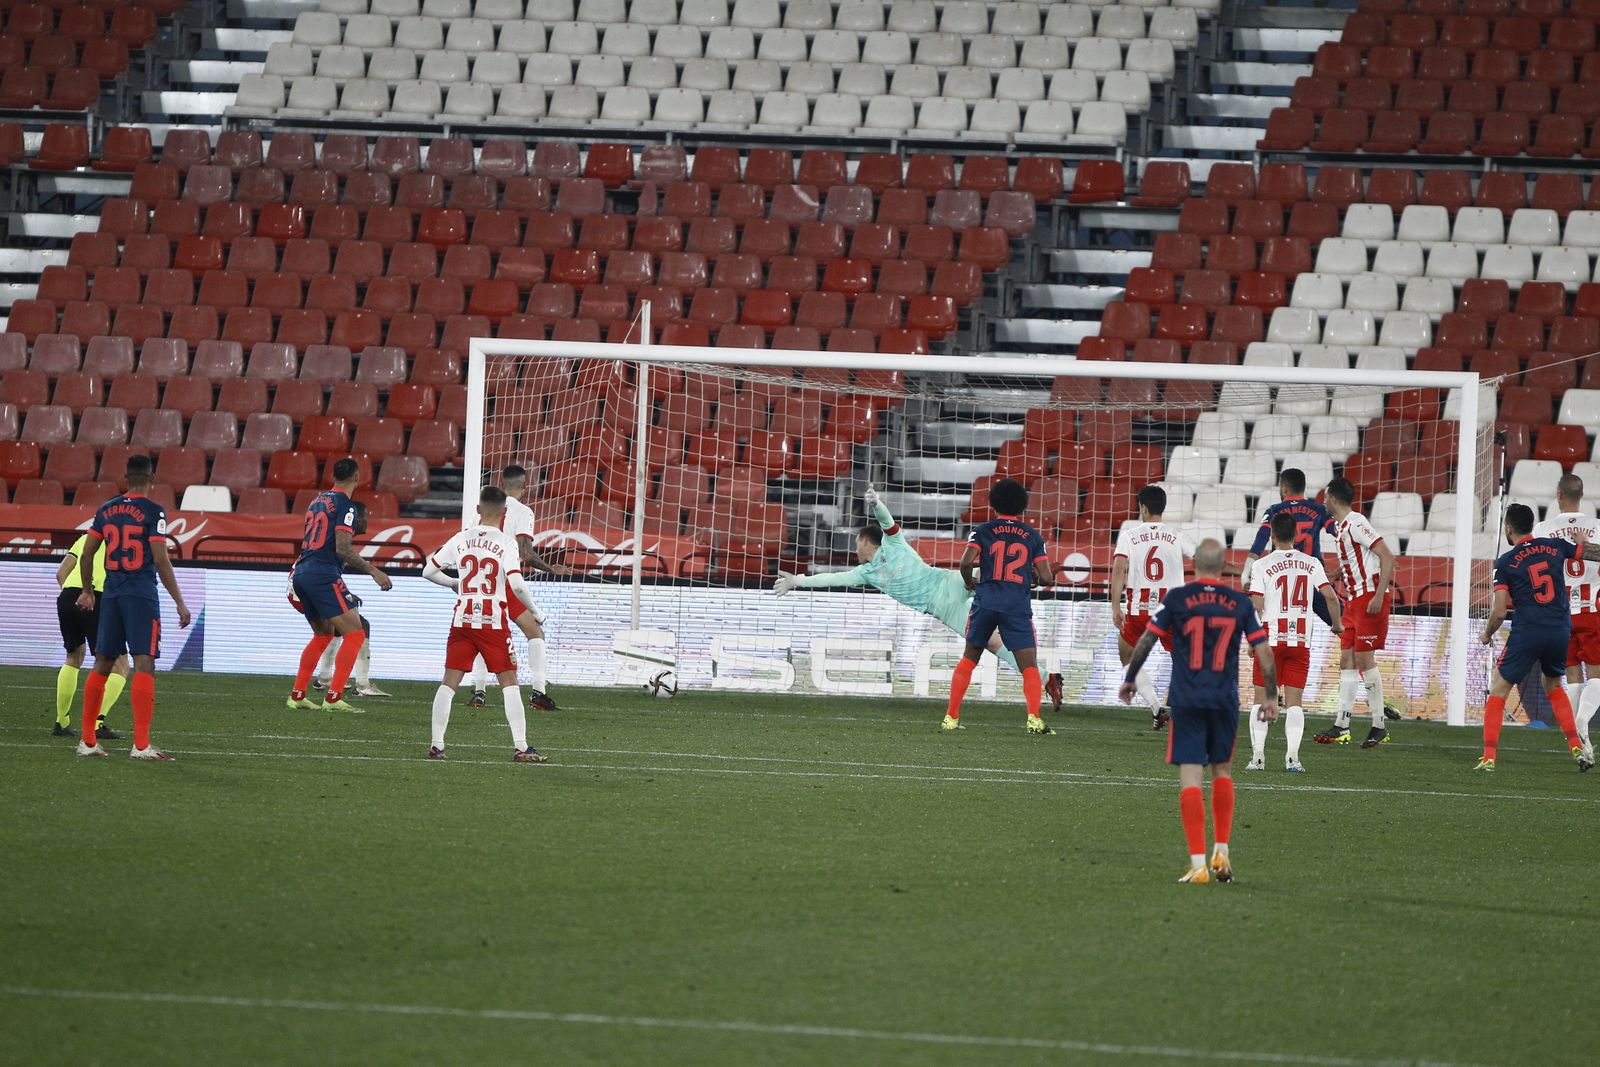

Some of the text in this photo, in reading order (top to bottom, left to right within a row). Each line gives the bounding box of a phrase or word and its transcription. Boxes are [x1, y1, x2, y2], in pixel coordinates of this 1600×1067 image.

[103, 504, 145, 522] FERNANDO
[301, 510, 329, 550] 20
[103, 524, 144, 571] 25
[466, 539, 504, 559] VILLALBA
[1292, 521, 1314, 556] 5
[459, 553, 499, 596] 23
[989, 540, 1029, 584] 12
[1144, 545, 1164, 582] 6
[1265, 559, 1316, 577] ROBERTONE
[1528, 560, 1556, 604] 5
[1275, 575, 1309, 615] 14
[1183, 615, 1237, 673] 17
